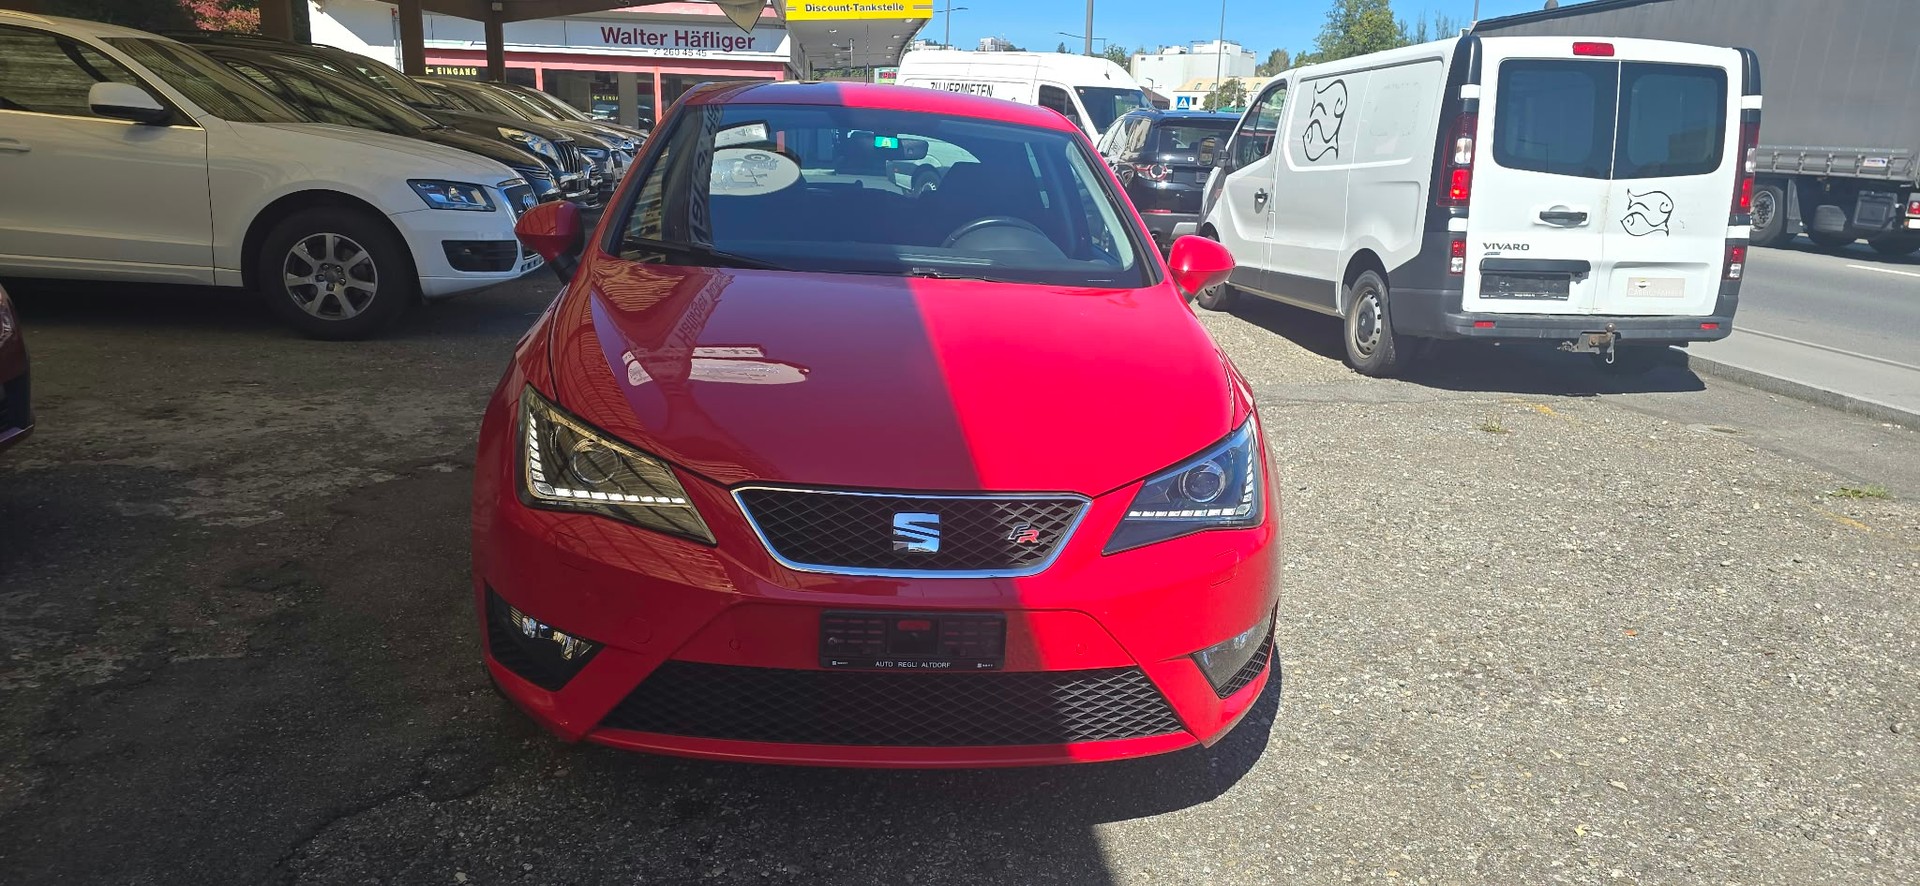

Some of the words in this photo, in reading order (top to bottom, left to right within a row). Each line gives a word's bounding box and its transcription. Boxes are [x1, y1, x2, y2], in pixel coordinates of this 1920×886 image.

[805, 3, 904, 12] Discount-Tankstelle
[601, 26, 668, 47] Walter
[674, 29, 755, 53] Häfliger
[663, 48, 680, 56] 260
[437, 67, 477, 76] EINGANG
[1482, 242, 1530, 251] VIVARO
[1007, 522, 1040, 544] FR
